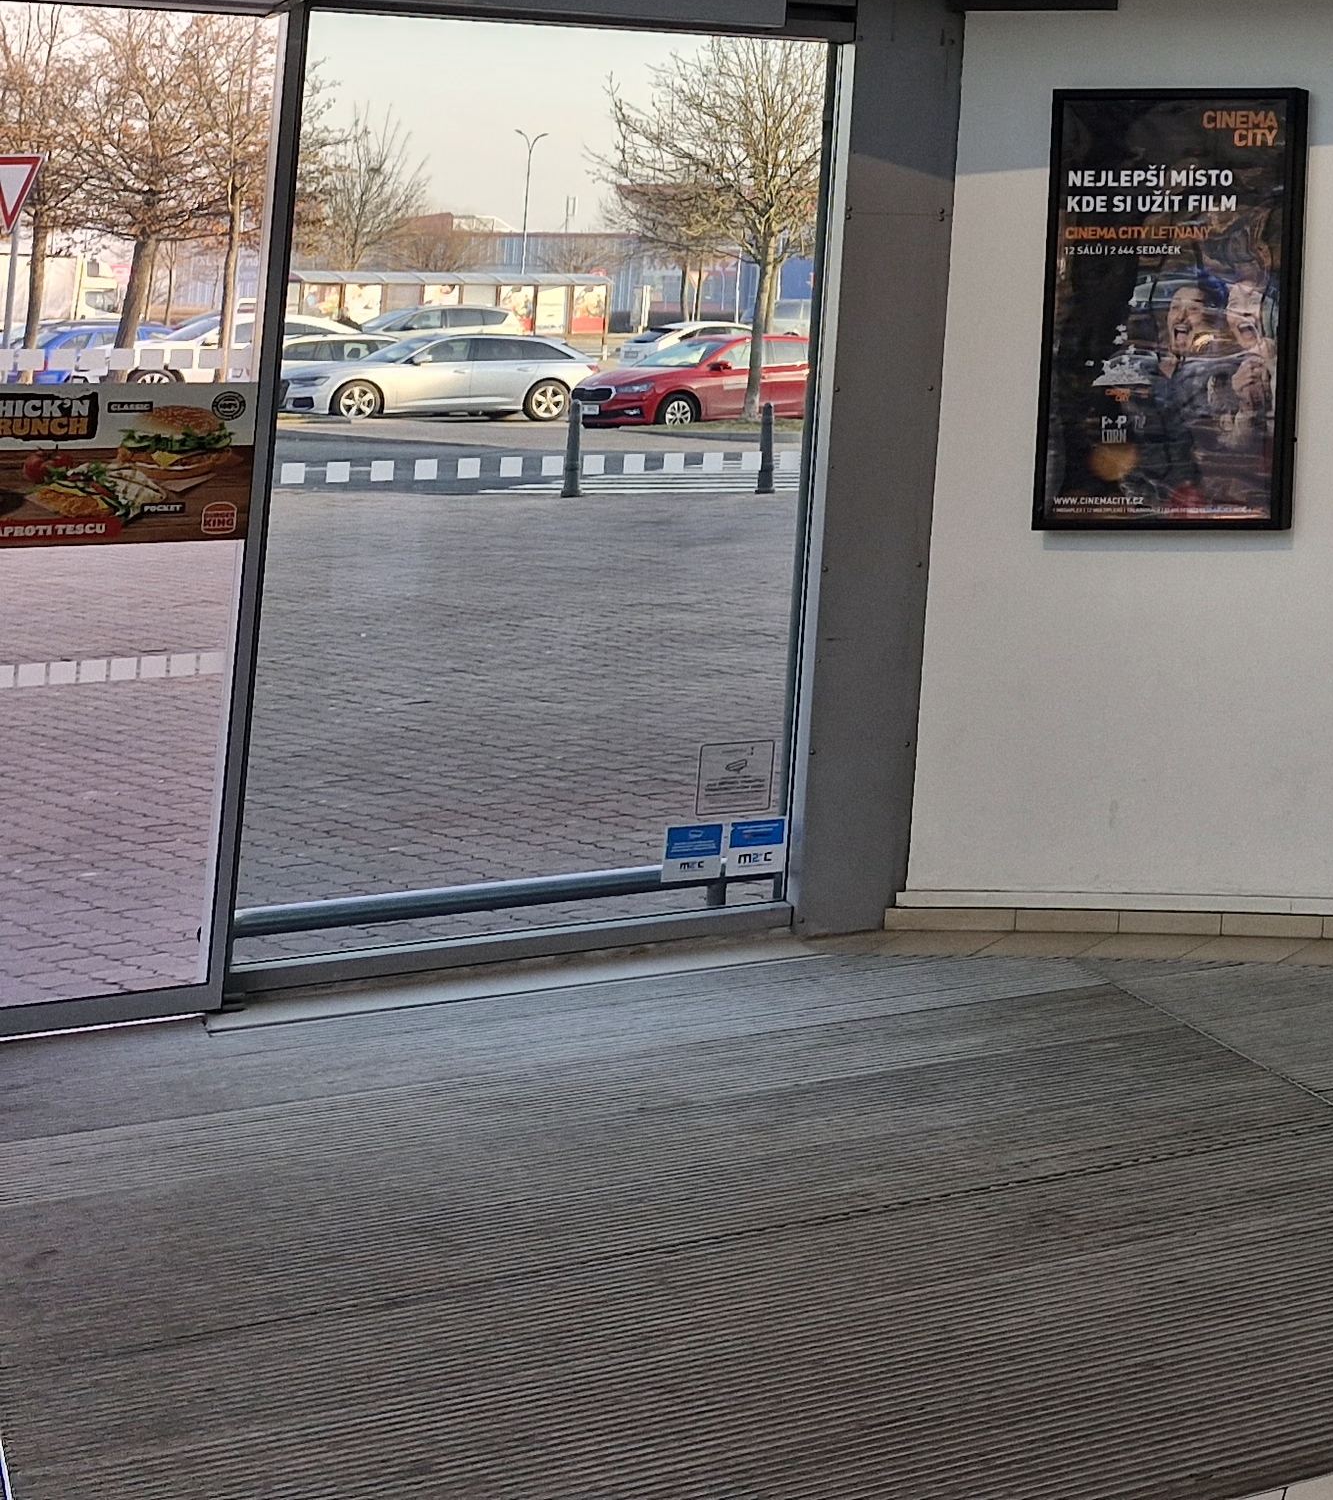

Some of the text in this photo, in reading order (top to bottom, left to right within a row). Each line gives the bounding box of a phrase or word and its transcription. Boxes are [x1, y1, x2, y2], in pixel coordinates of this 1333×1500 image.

[1203, 111, 1278, 129] CINEMA
[1233, 129, 1278, 147] CITY
[1068, 165, 1233, 187] NEJLEPŠÍ MÍSTO
[1067, 190, 1237, 213] KDE SI UŽÍT FILM
[1065, 226, 1116, 239] CINEMA
[1118, 226, 1148, 239] CITY
[1064, 246, 1075, 256] 12
[1136, 243, 1181, 255] SEDAČEK
[111, 403, 151, 411] CLASSIC
[1053, 496, 1144, 505] WWW.CINEMACITY.CZ
[144, 504, 182, 513] POCKET
[55, 523, 106, 535] TESCU
[204, 518, 234, 527] KING
